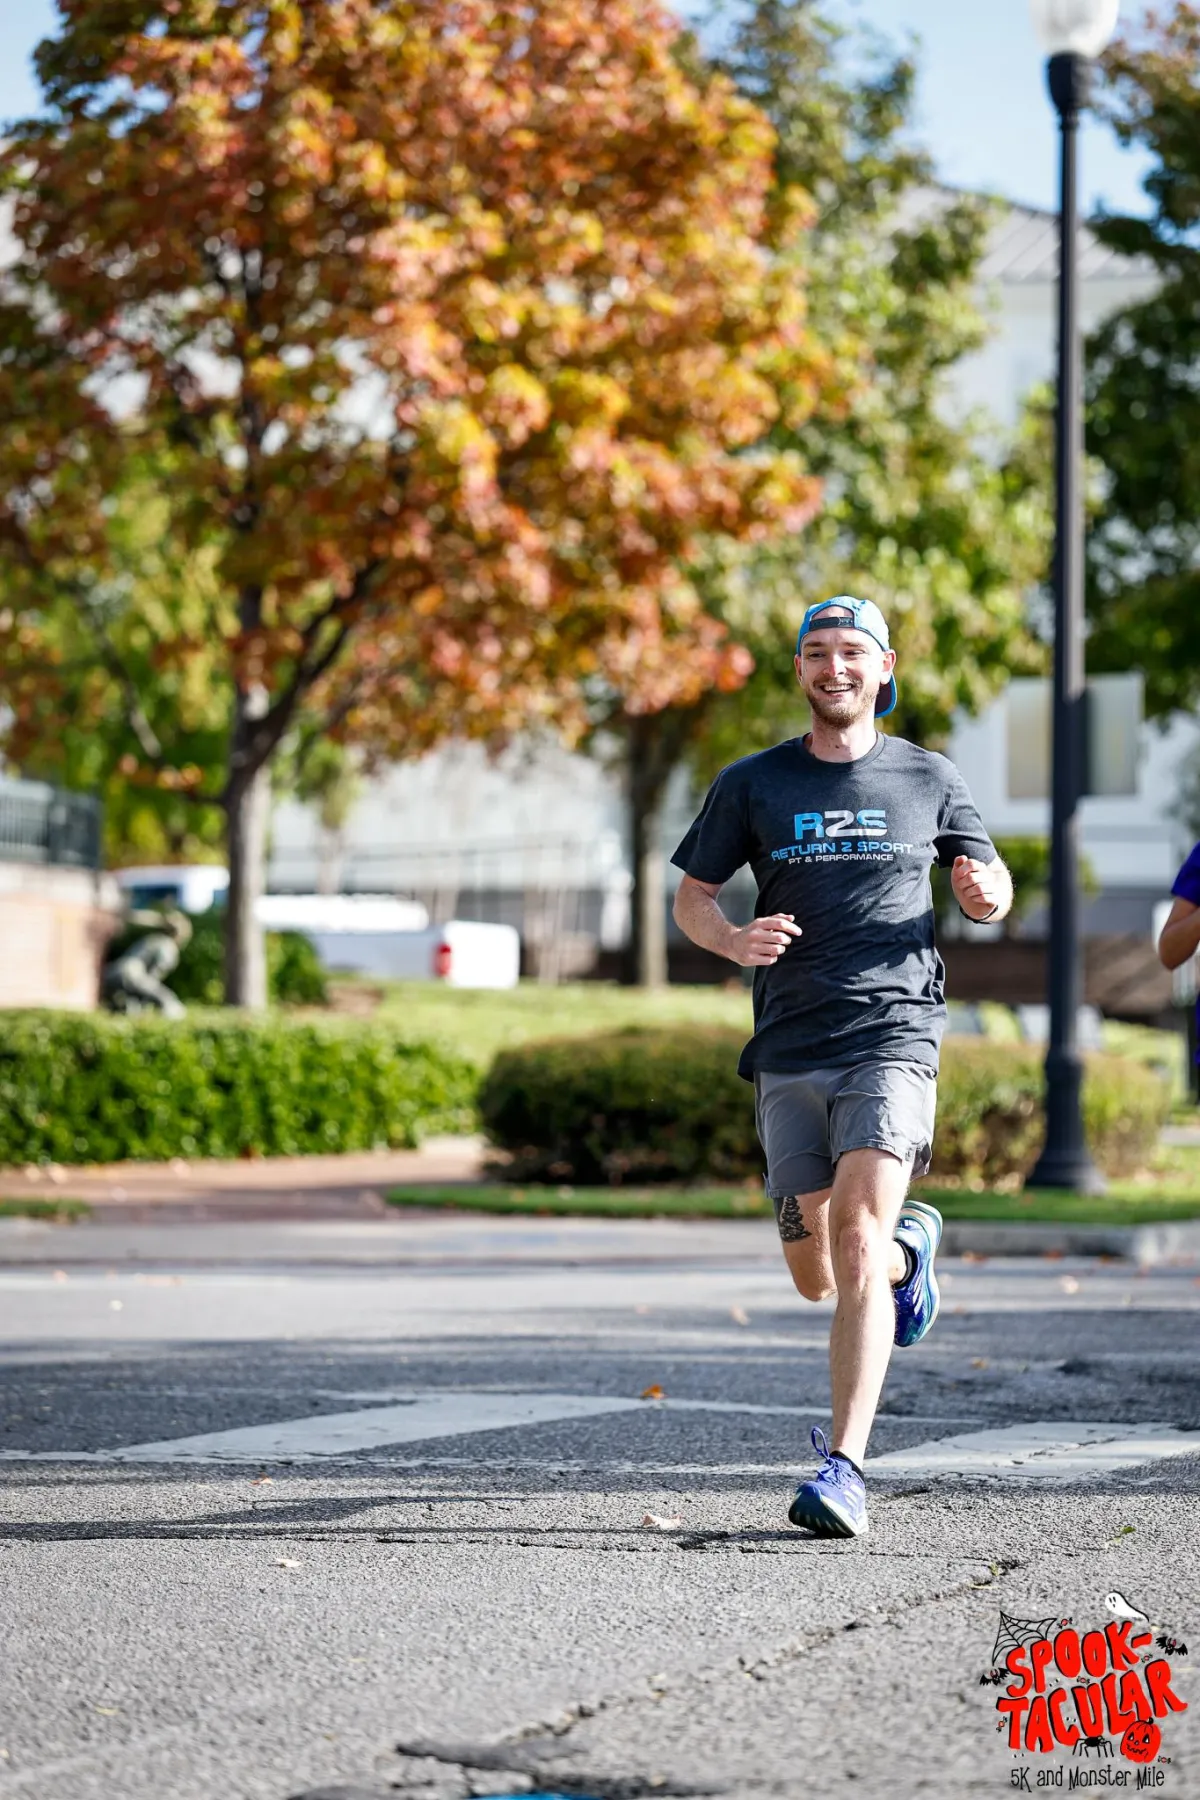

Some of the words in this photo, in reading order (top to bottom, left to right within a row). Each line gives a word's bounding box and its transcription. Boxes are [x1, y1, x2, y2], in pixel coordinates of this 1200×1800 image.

[794, 809, 888, 840] R2S
[771, 842, 836, 861] RETURN
[841, 841, 852, 853] 2
[857, 841, 913, 854] SPORT
[788, 857, 802, 865] PT
[804, 855, 813, 863] &
[815, 853, 894, 862] PERFORMANCE
